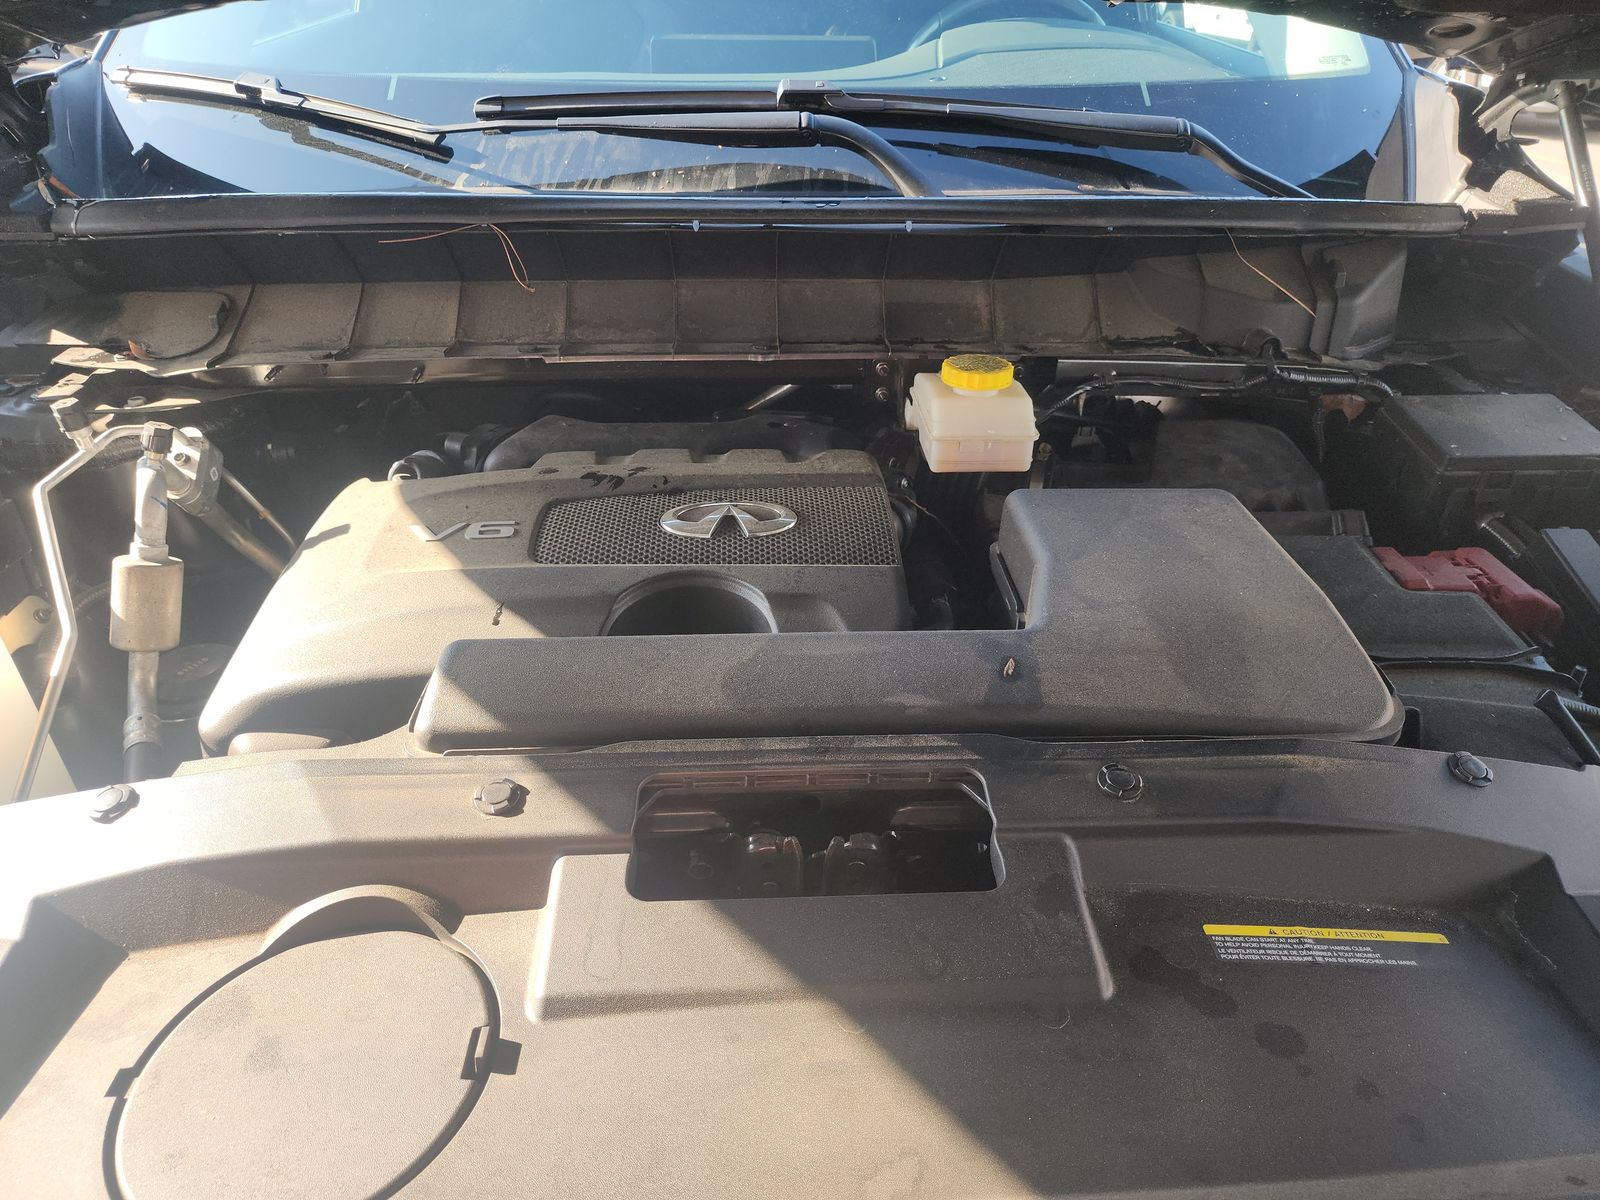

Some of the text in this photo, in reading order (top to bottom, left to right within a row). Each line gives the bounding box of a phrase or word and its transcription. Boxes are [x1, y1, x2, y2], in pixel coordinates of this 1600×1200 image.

[408, 520, 519, 541] V6
[1282, 928, 1324, 937] CAUTION
[1335, 931, 1385, 939] ATTENTION
